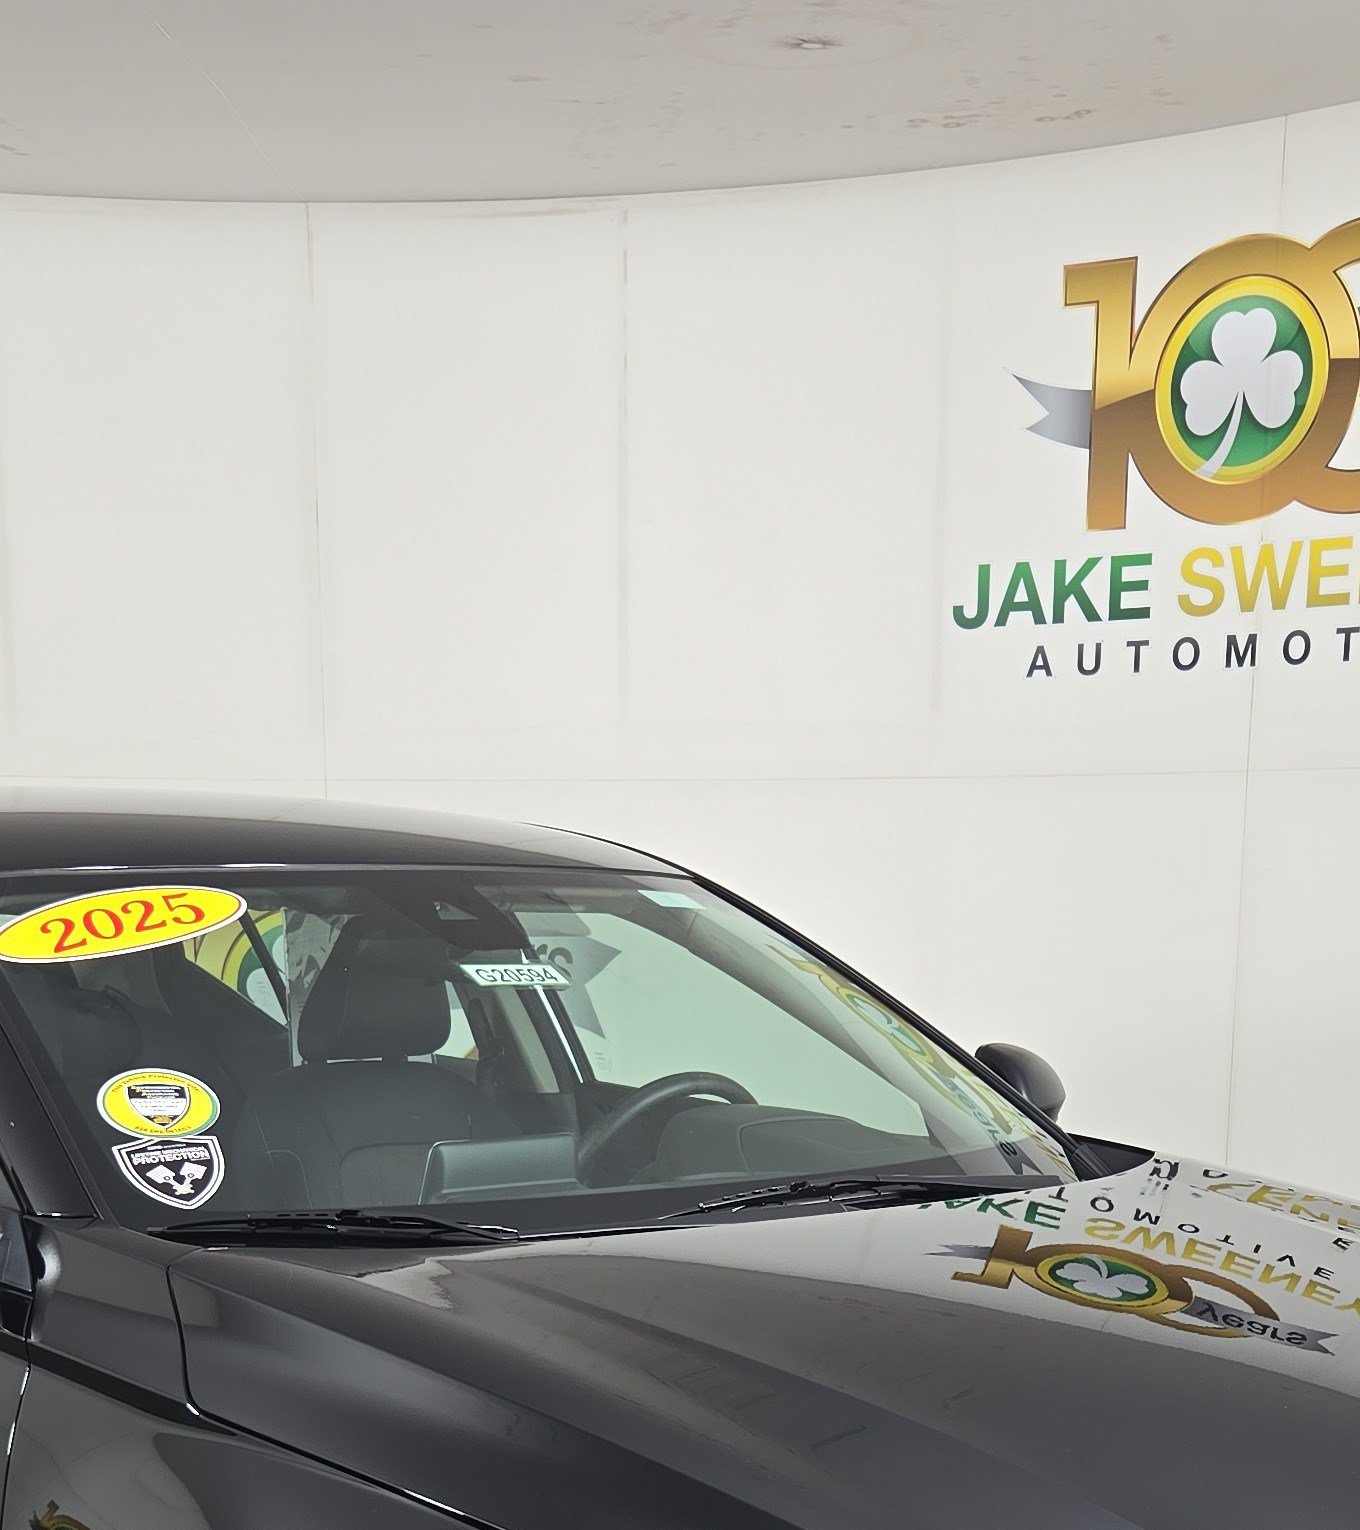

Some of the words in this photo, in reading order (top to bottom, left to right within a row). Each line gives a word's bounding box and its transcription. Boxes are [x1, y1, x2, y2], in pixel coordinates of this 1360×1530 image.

[952, 553, 1153, 629] JAKE
[40, 893, 205, 953] 2025
[475, 967, 559, 983] G20594
